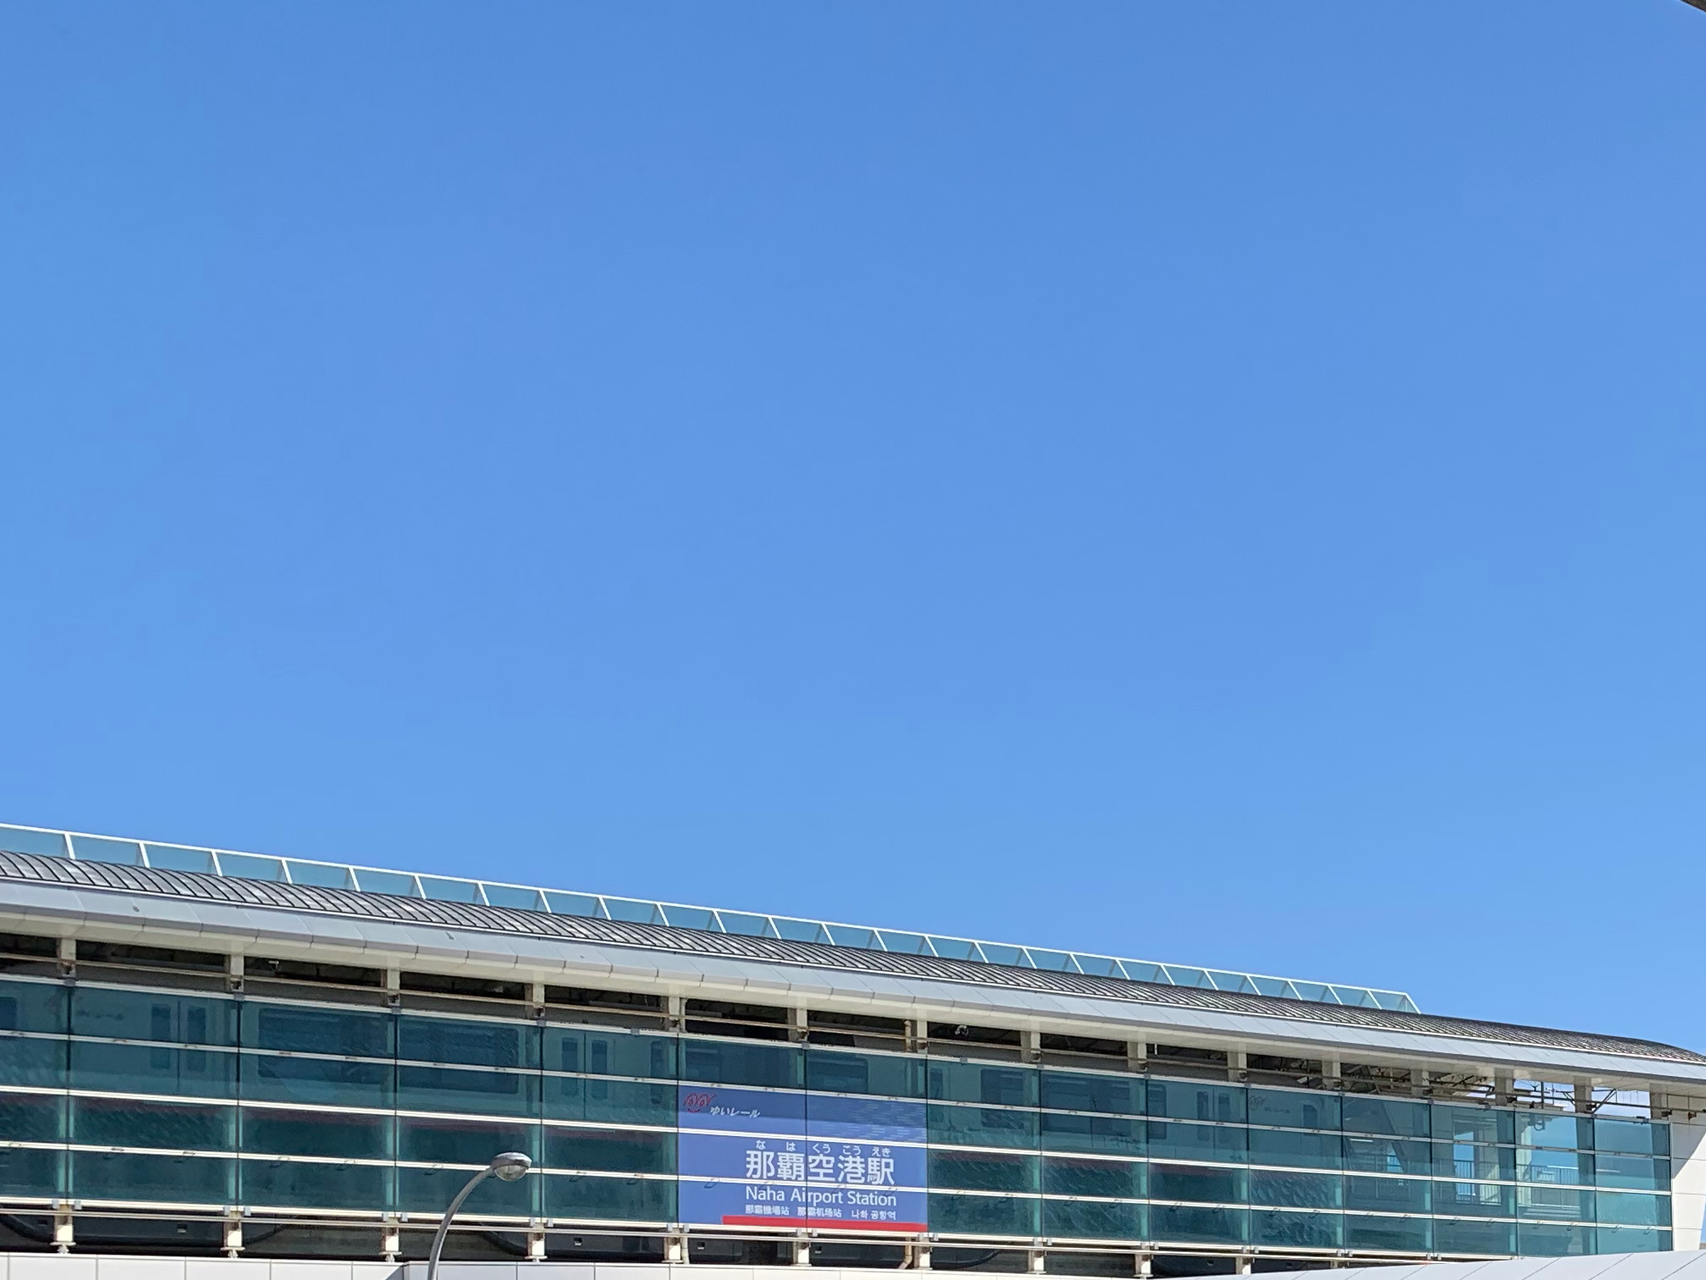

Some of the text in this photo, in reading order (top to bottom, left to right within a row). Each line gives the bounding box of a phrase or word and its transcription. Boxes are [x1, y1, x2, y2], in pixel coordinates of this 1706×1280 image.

[710, 1106, 760, 1118] ゆいレール
[746, 1150, 895, 1185] 那覇空港駅
[746, 1186, 897, 1207] Naha Airport Station
